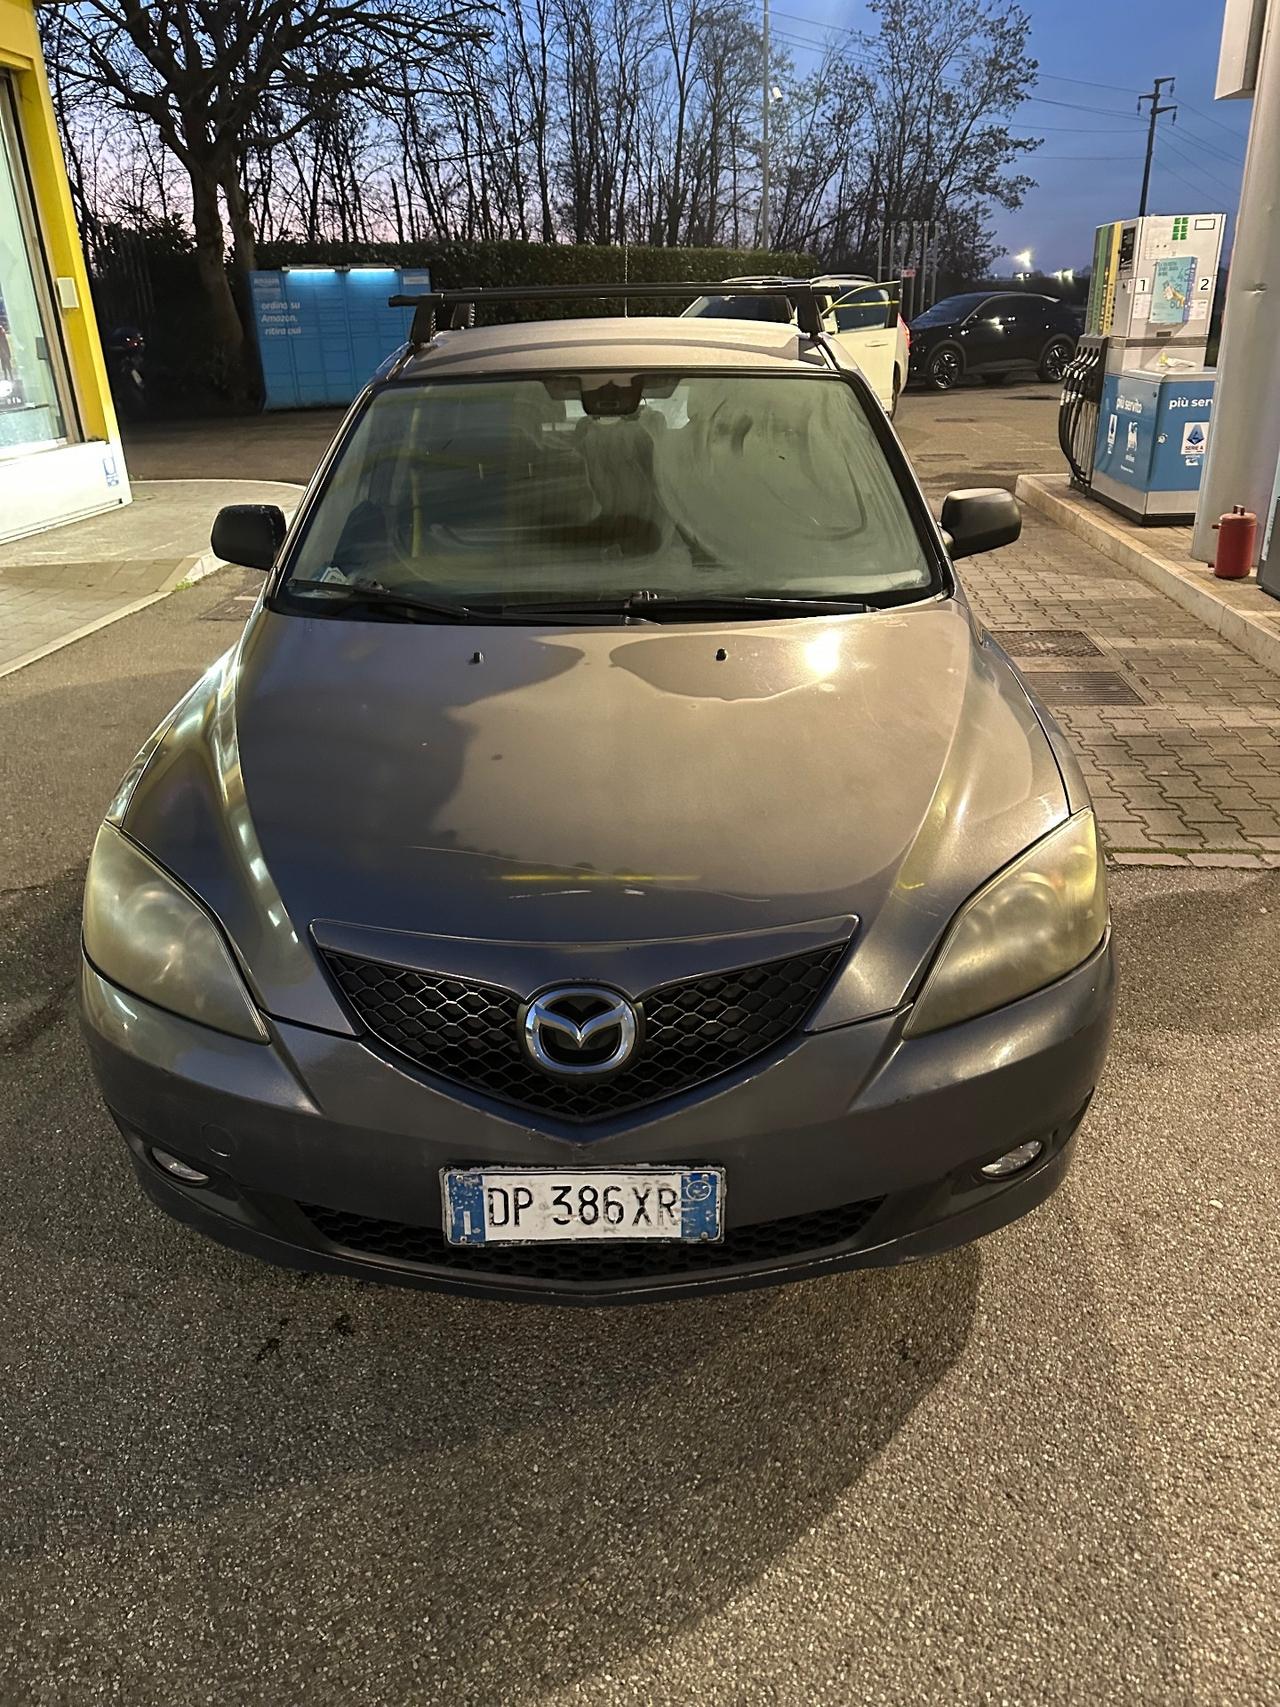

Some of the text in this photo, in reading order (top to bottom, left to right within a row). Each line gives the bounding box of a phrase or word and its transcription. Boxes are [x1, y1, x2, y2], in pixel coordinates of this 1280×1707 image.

[1200, 278, 1210, 291] 2
[290, 301, 301, 310] su
[1168, 397, 1188, 410] più
[487, 1185, 679, 1227] DP 386XR
